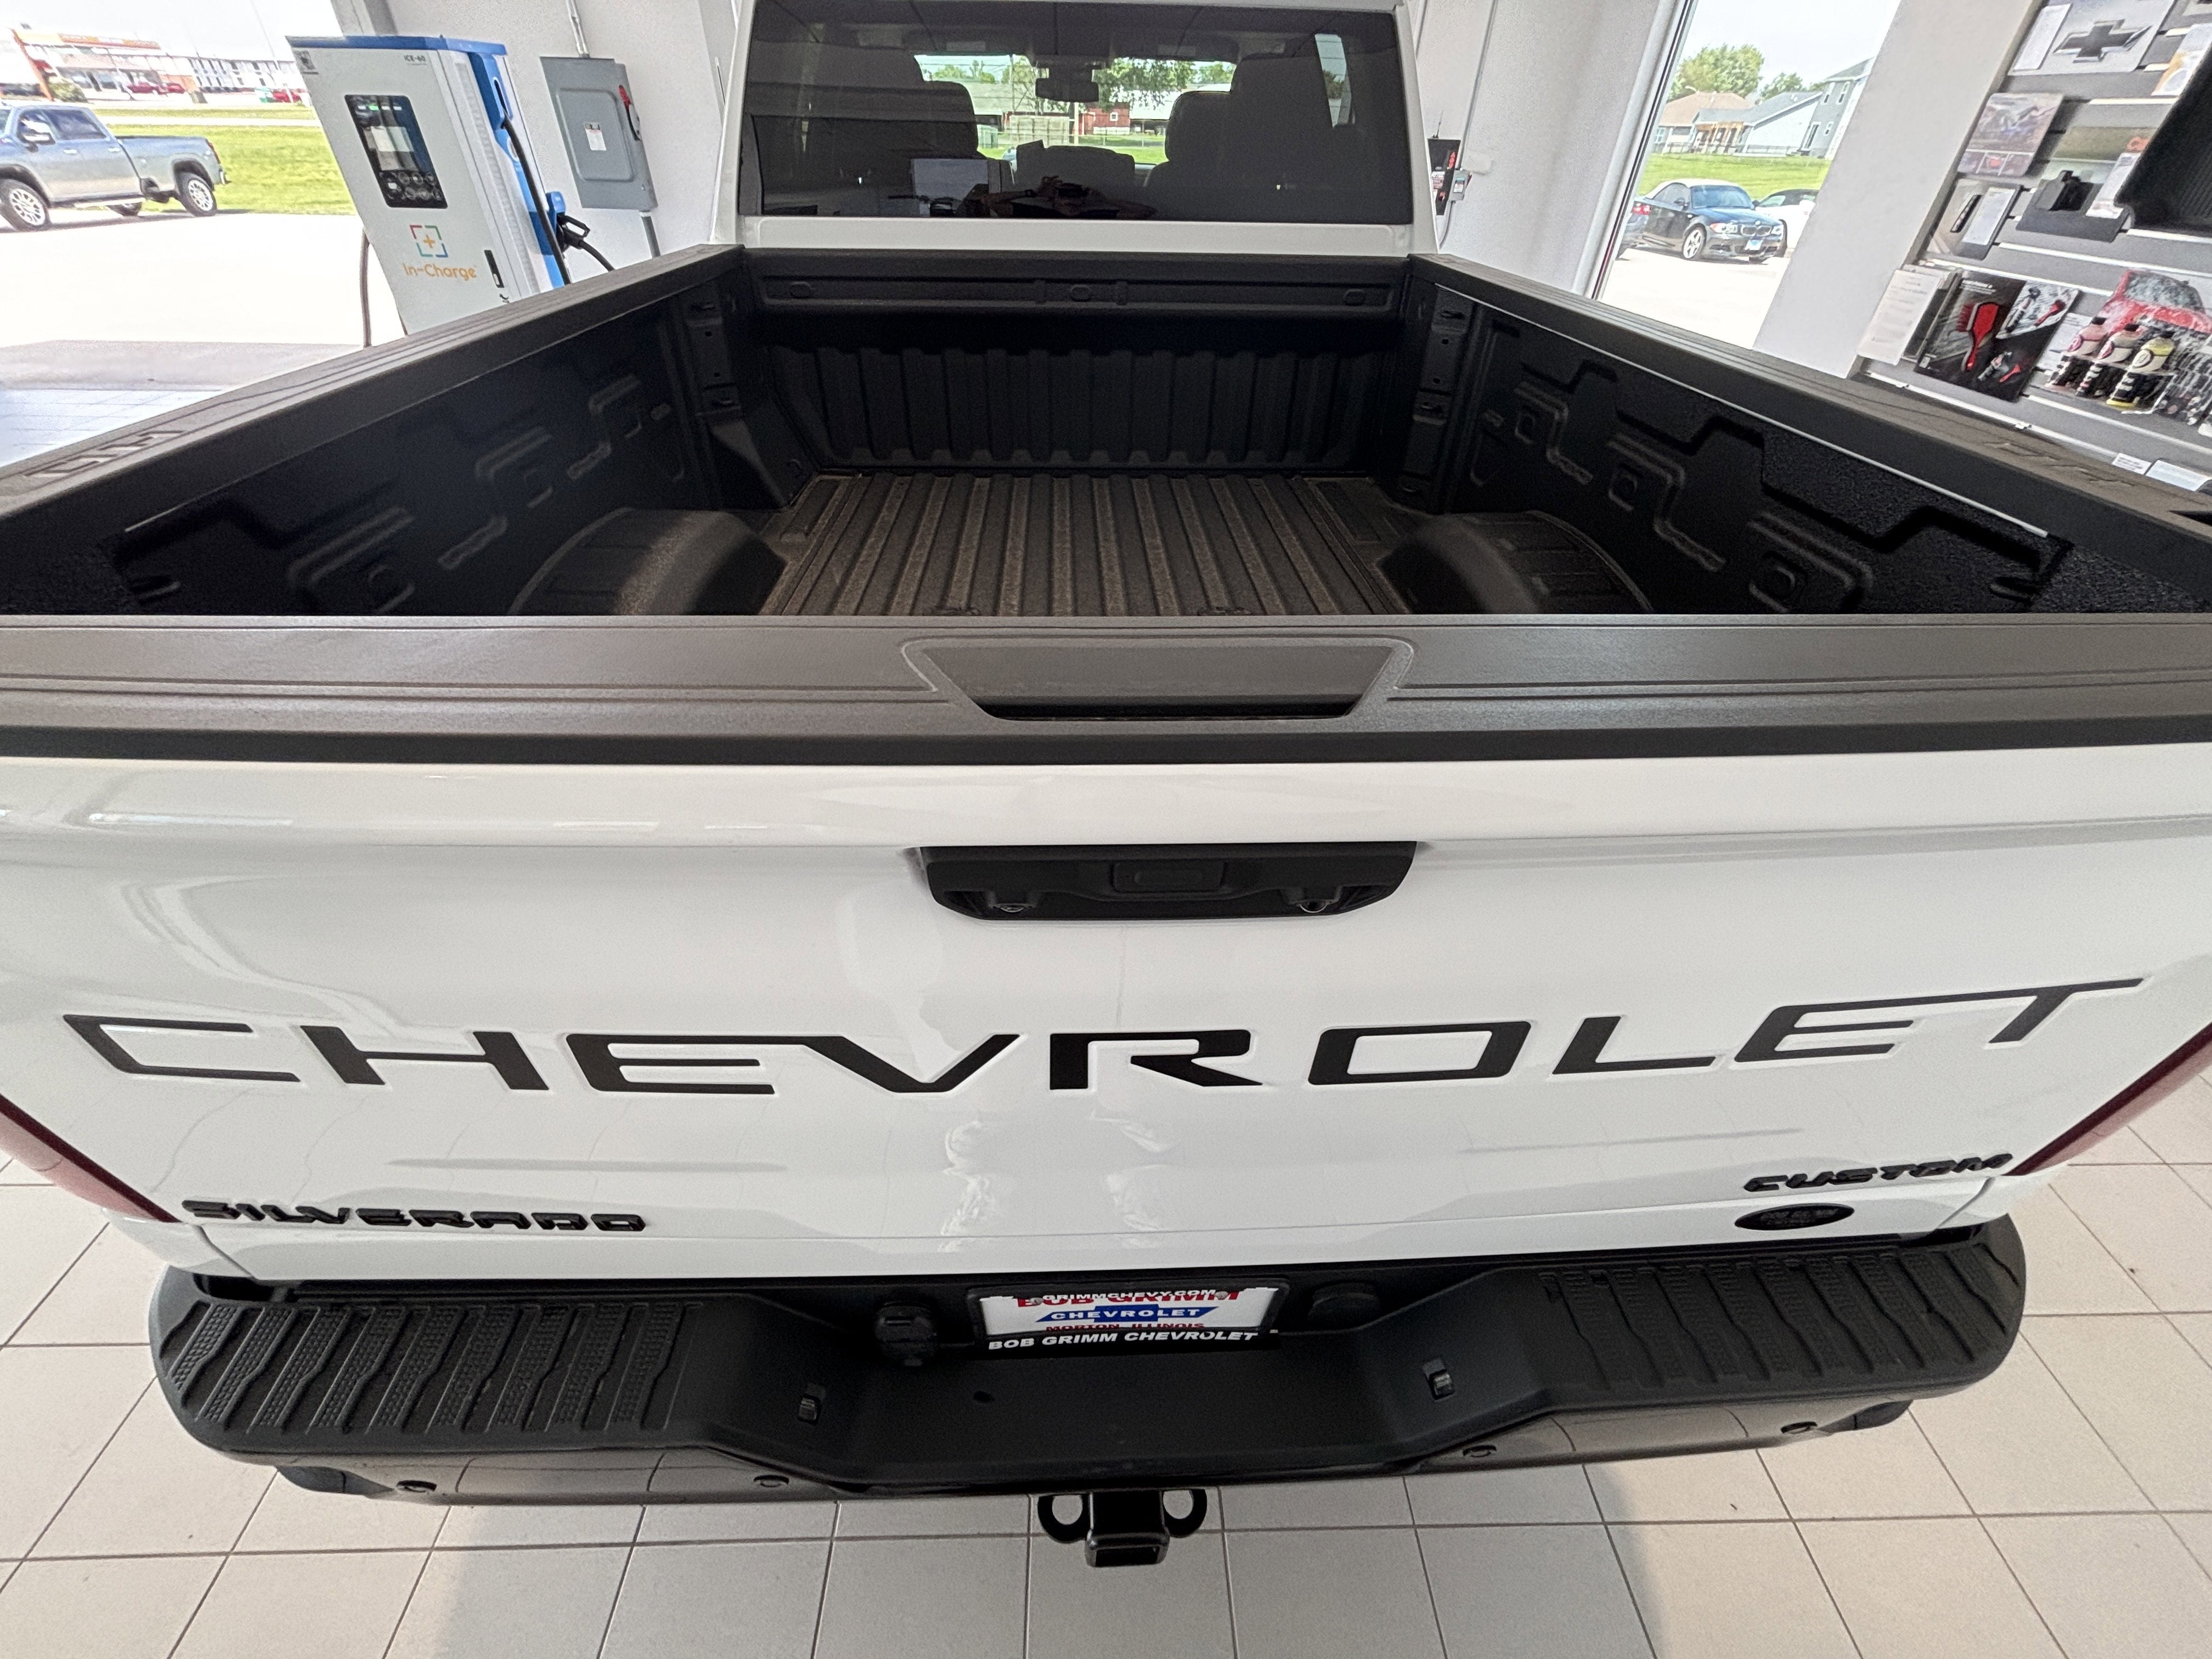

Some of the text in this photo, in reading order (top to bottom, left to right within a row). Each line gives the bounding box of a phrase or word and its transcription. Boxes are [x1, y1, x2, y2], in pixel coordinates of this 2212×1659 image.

[403, 263, 477, 281] In-Charge
[63, 979, 2143, 1094] CHEVROLET
[1743, 1153, 2013, 1192] CUSTOM
[182, 1200, 647, 1232] SILVERADO
[1043, 1289, 1216, 1300] GRIMMCHEVY.COM
[1051, 1309, 1200, 1319] CHEVROLET
[989, 1331, 1259, 1350] BOB GRIMM CHEVROLET
